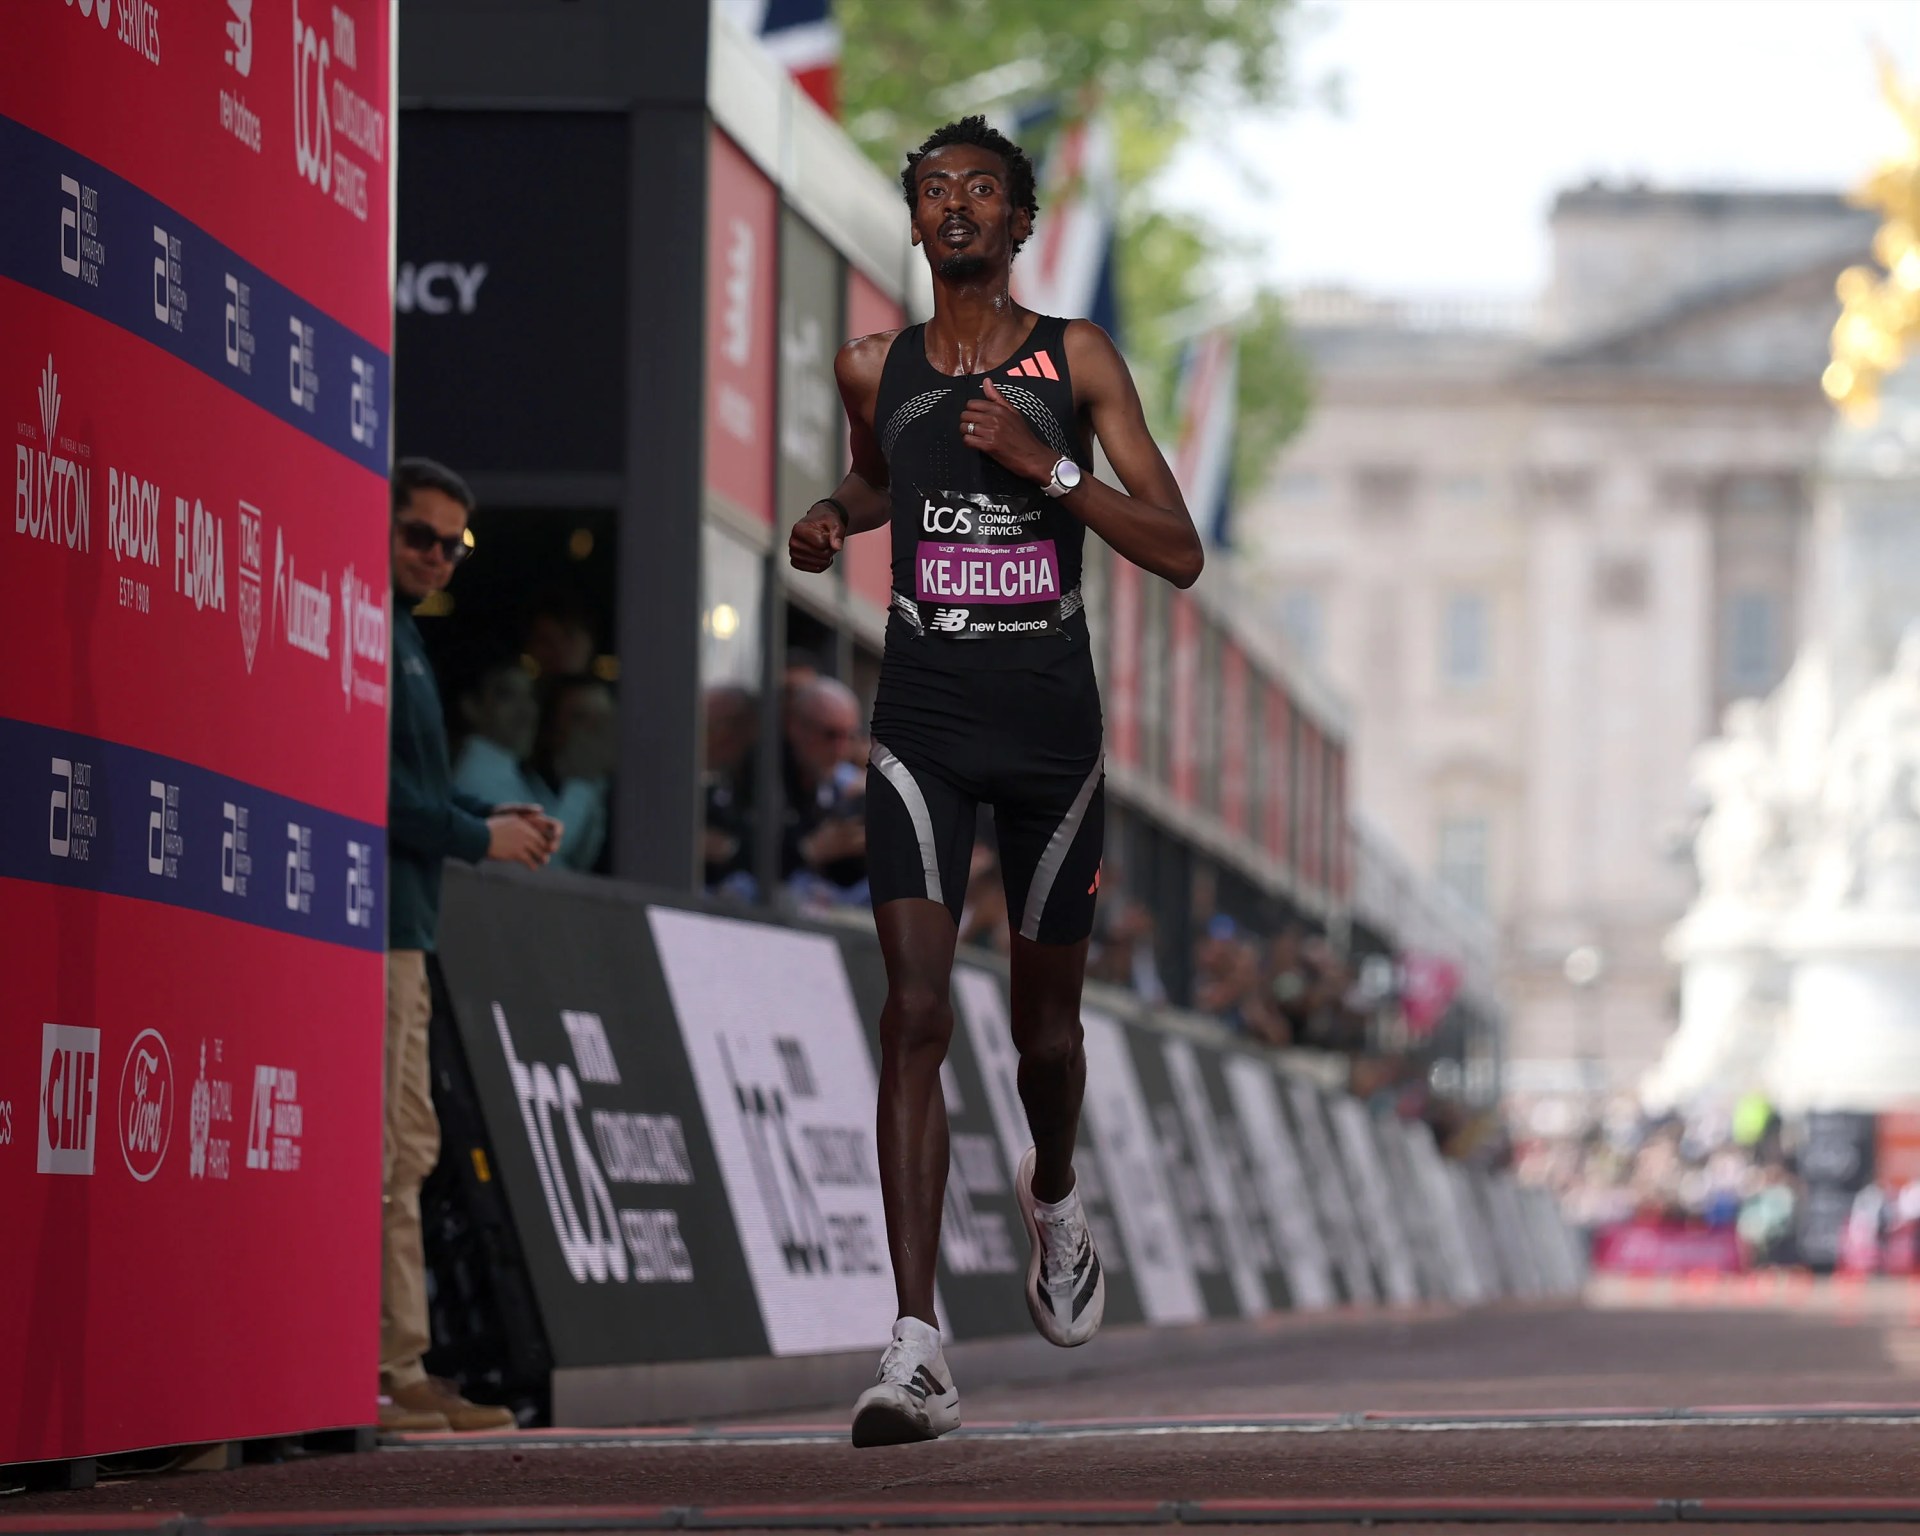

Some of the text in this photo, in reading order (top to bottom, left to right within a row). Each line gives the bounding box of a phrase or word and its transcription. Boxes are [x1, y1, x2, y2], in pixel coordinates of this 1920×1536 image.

[117, 0, 160, 66] SERVICES
[81, 210, 98, 237] WORLD
[81, 259, 99, 288] MAJORS
[15, 443, 90, 554] BUXTON
[108, 466, 160, 568] RADOX
[923, 499, 972, 535] tcs
[978, 525, 1023, 536] SERVICES
[175, 496, 225, 613] FLORA
[921, 557, 1055, 597] KEJELCHA
[970, 617, 1048, 632] new balance
[73, 762, 92, 787] ABBOTT
[72, 787, 90, 811] WORLD
[72, 812, 98, 838] MARATHON
[71, 837, 89, 861] MAJORS
[47, 1048, 95, 1151] CLIF
[128, 1048, 166, 1154] Ford
